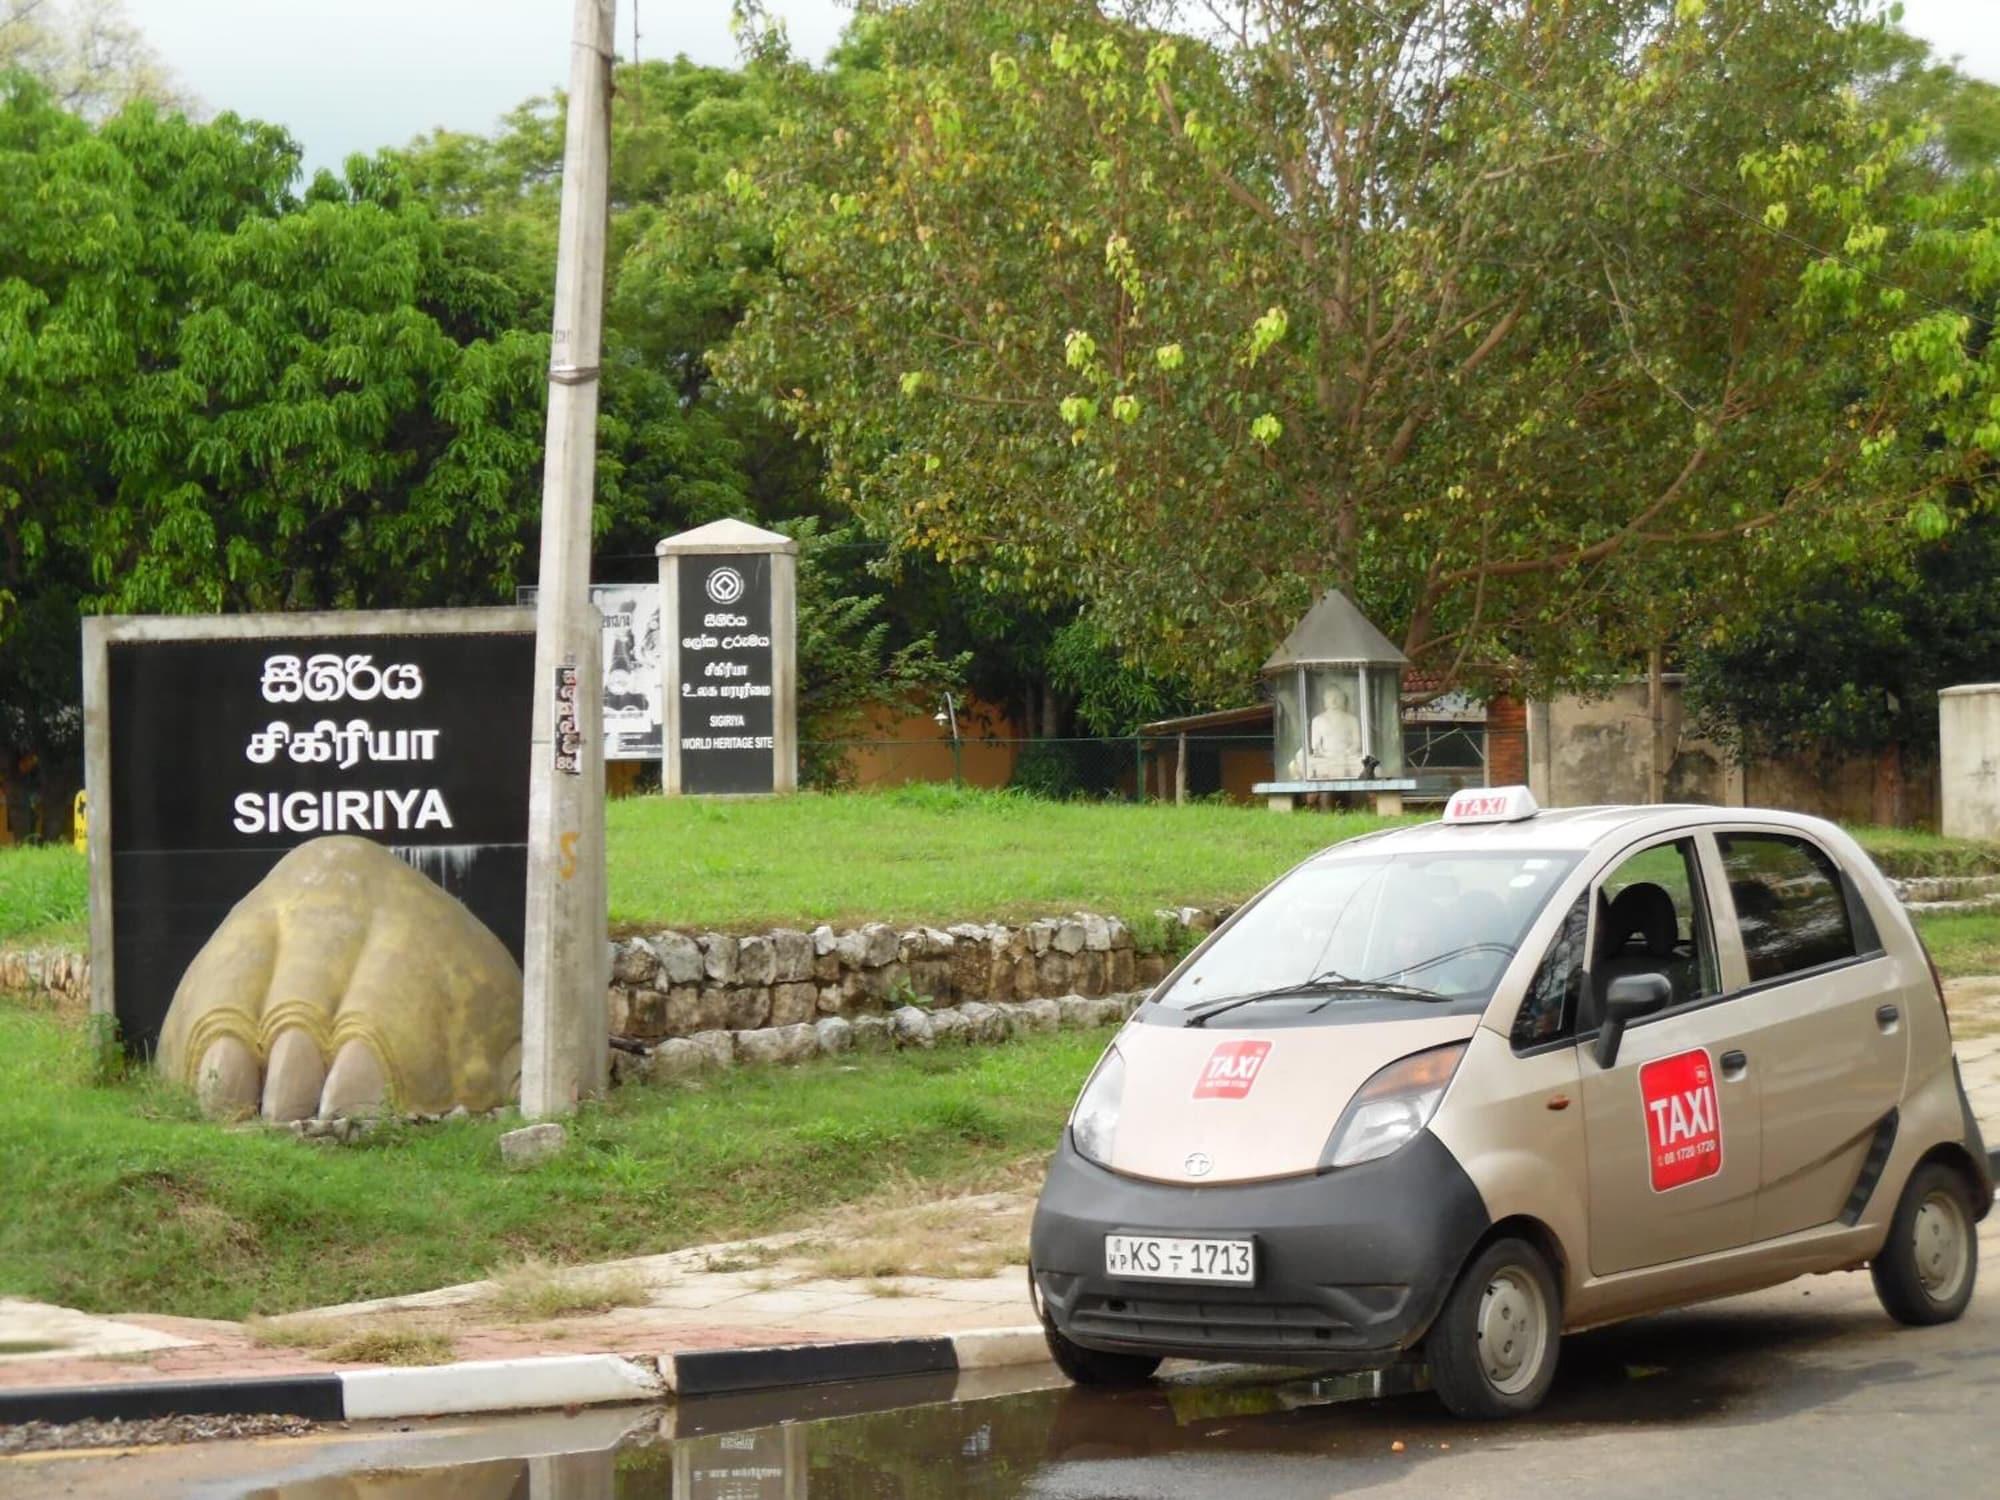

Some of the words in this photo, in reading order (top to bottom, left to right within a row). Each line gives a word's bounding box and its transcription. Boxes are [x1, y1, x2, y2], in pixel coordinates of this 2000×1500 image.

[709, 714, 745, 728] SIGIRIYA
[681, 737, 712, 750] WORLD
[713, 736, 754, 750] HERITAGE
[755, 736, 773, 749] SITE
[233, 788, 453, 833] SIGIRIYA
[1458, 797, 1506, 816] TAXI
[1208, 1055, 1261, 1079] TAXI
[1650, 1086, 1714, 1146] TAXI
